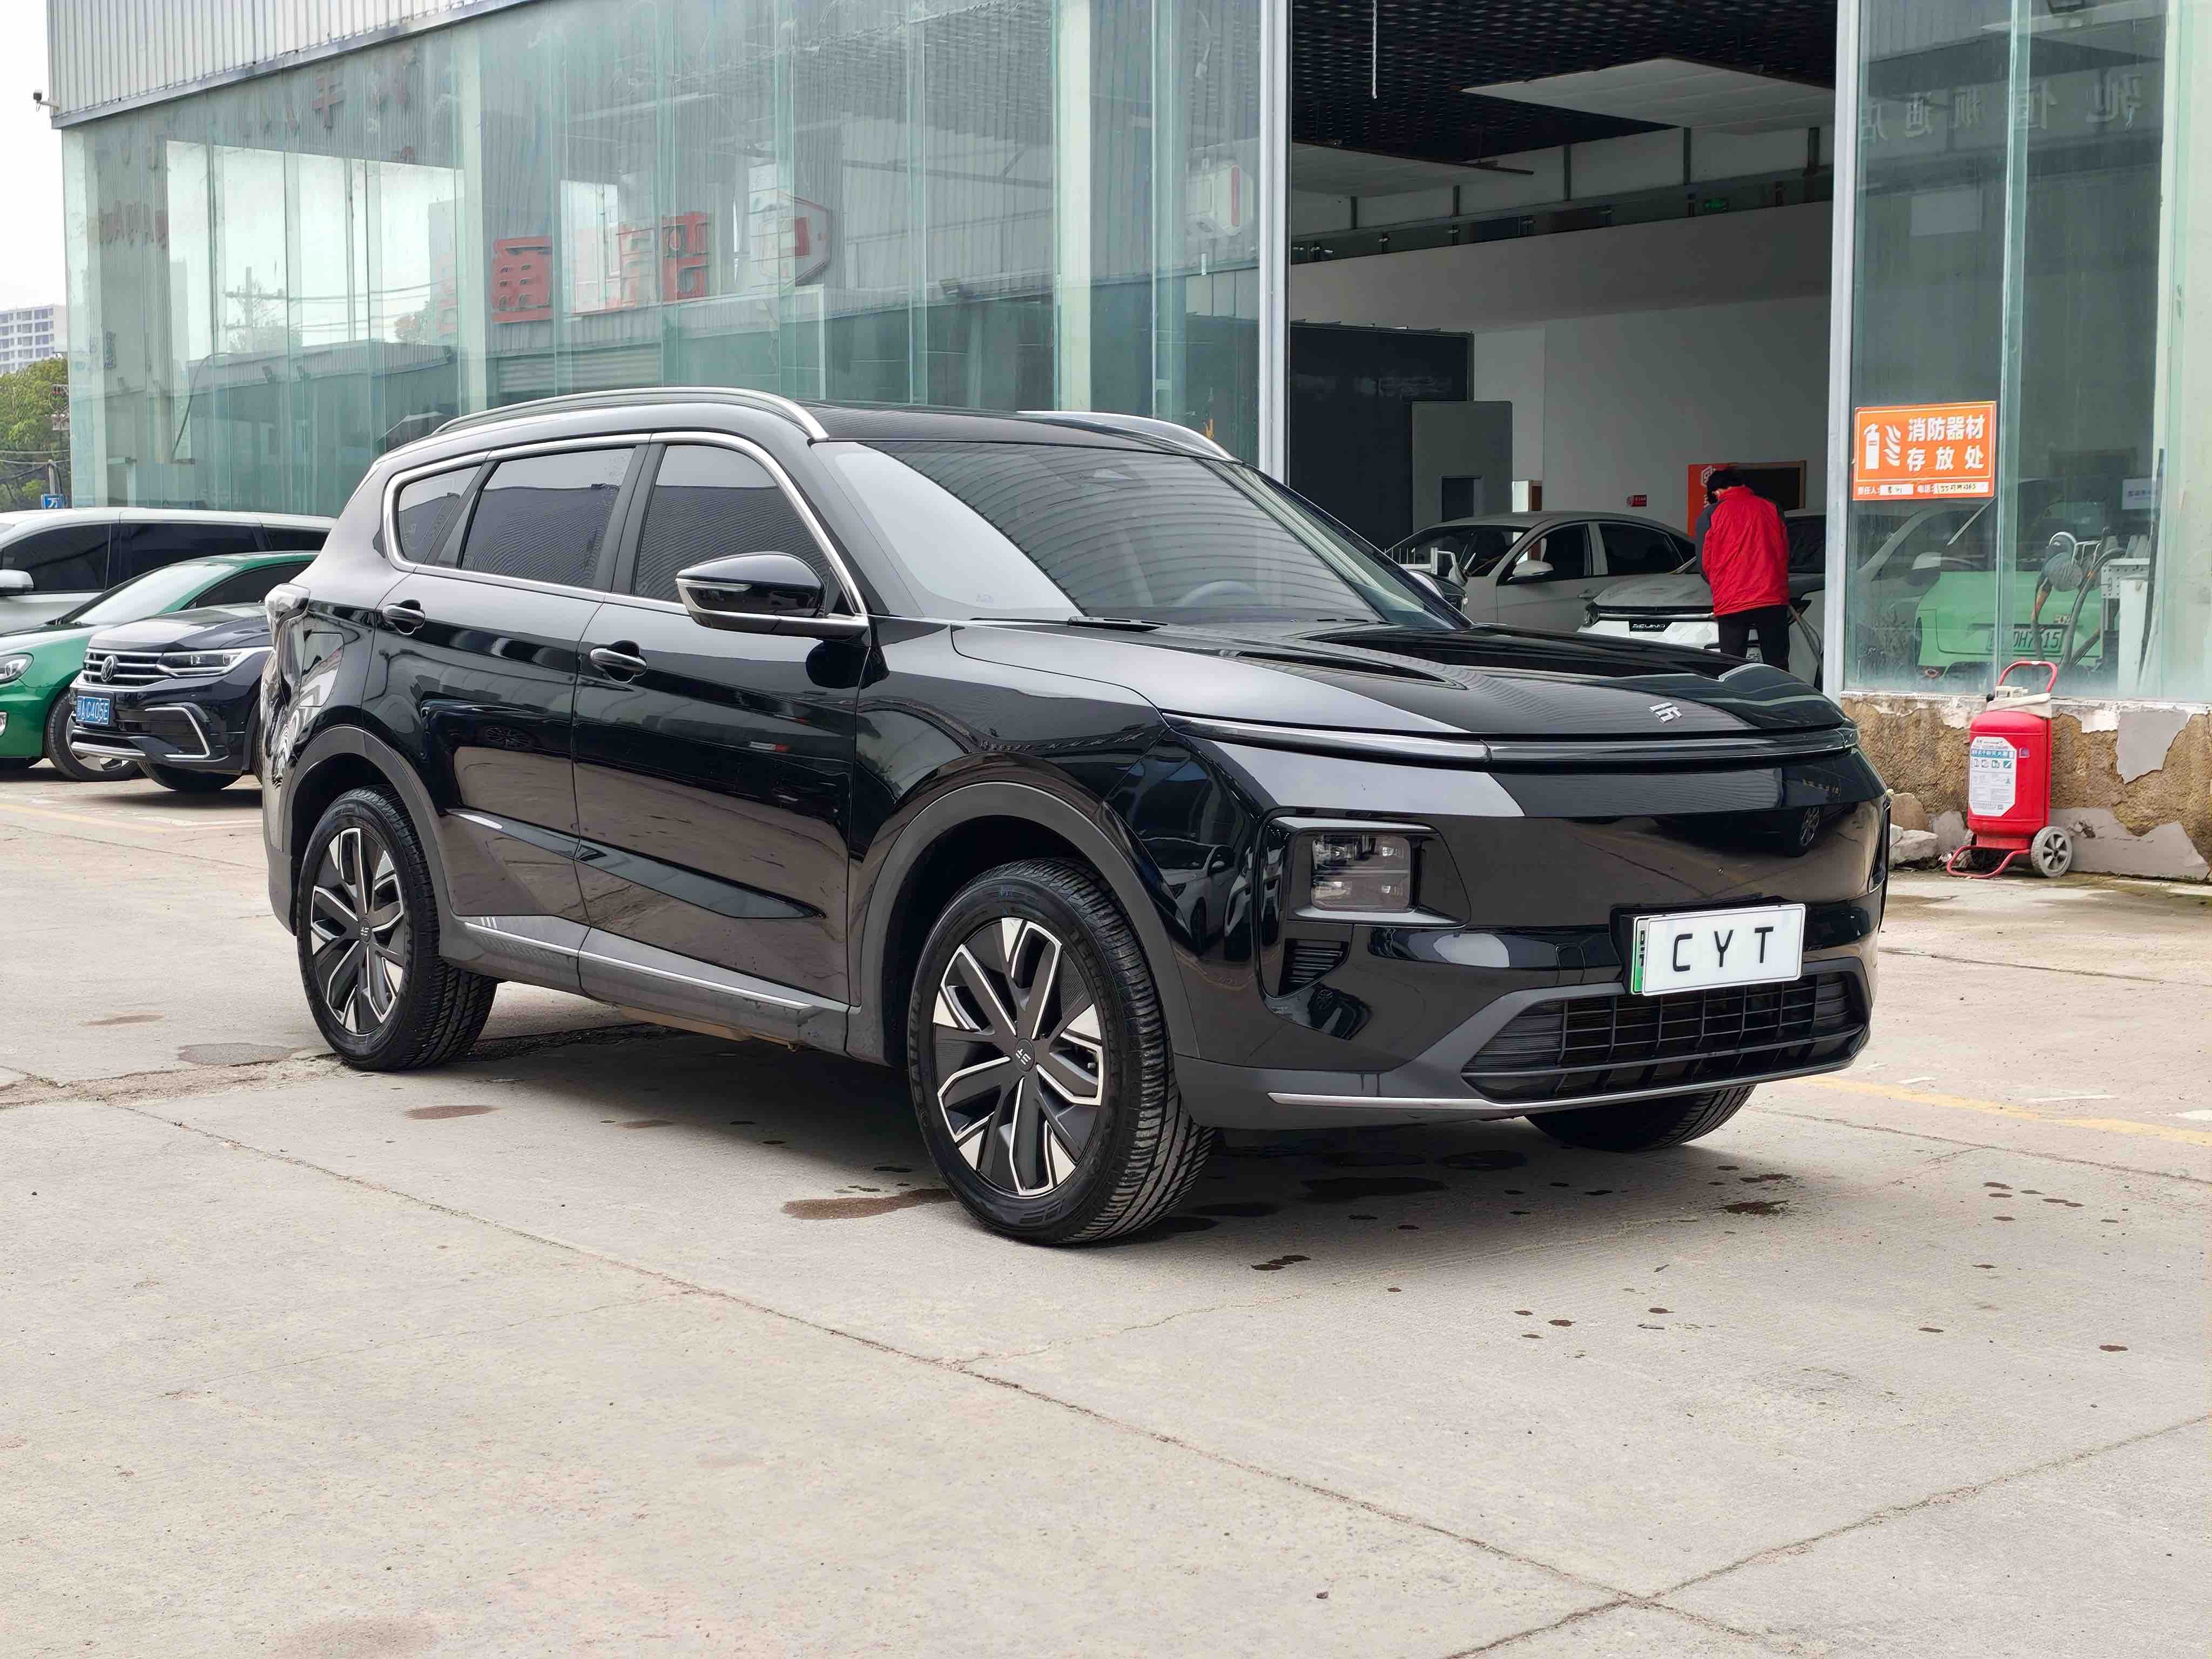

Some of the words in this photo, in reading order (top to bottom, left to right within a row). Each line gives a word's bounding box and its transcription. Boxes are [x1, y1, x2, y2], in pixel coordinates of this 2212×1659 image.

[1907, 415, 1985, 442] 消防器材
[1907, 445, 1985, 471] 存放处
[1673, 926, 1774, 972] CYT
